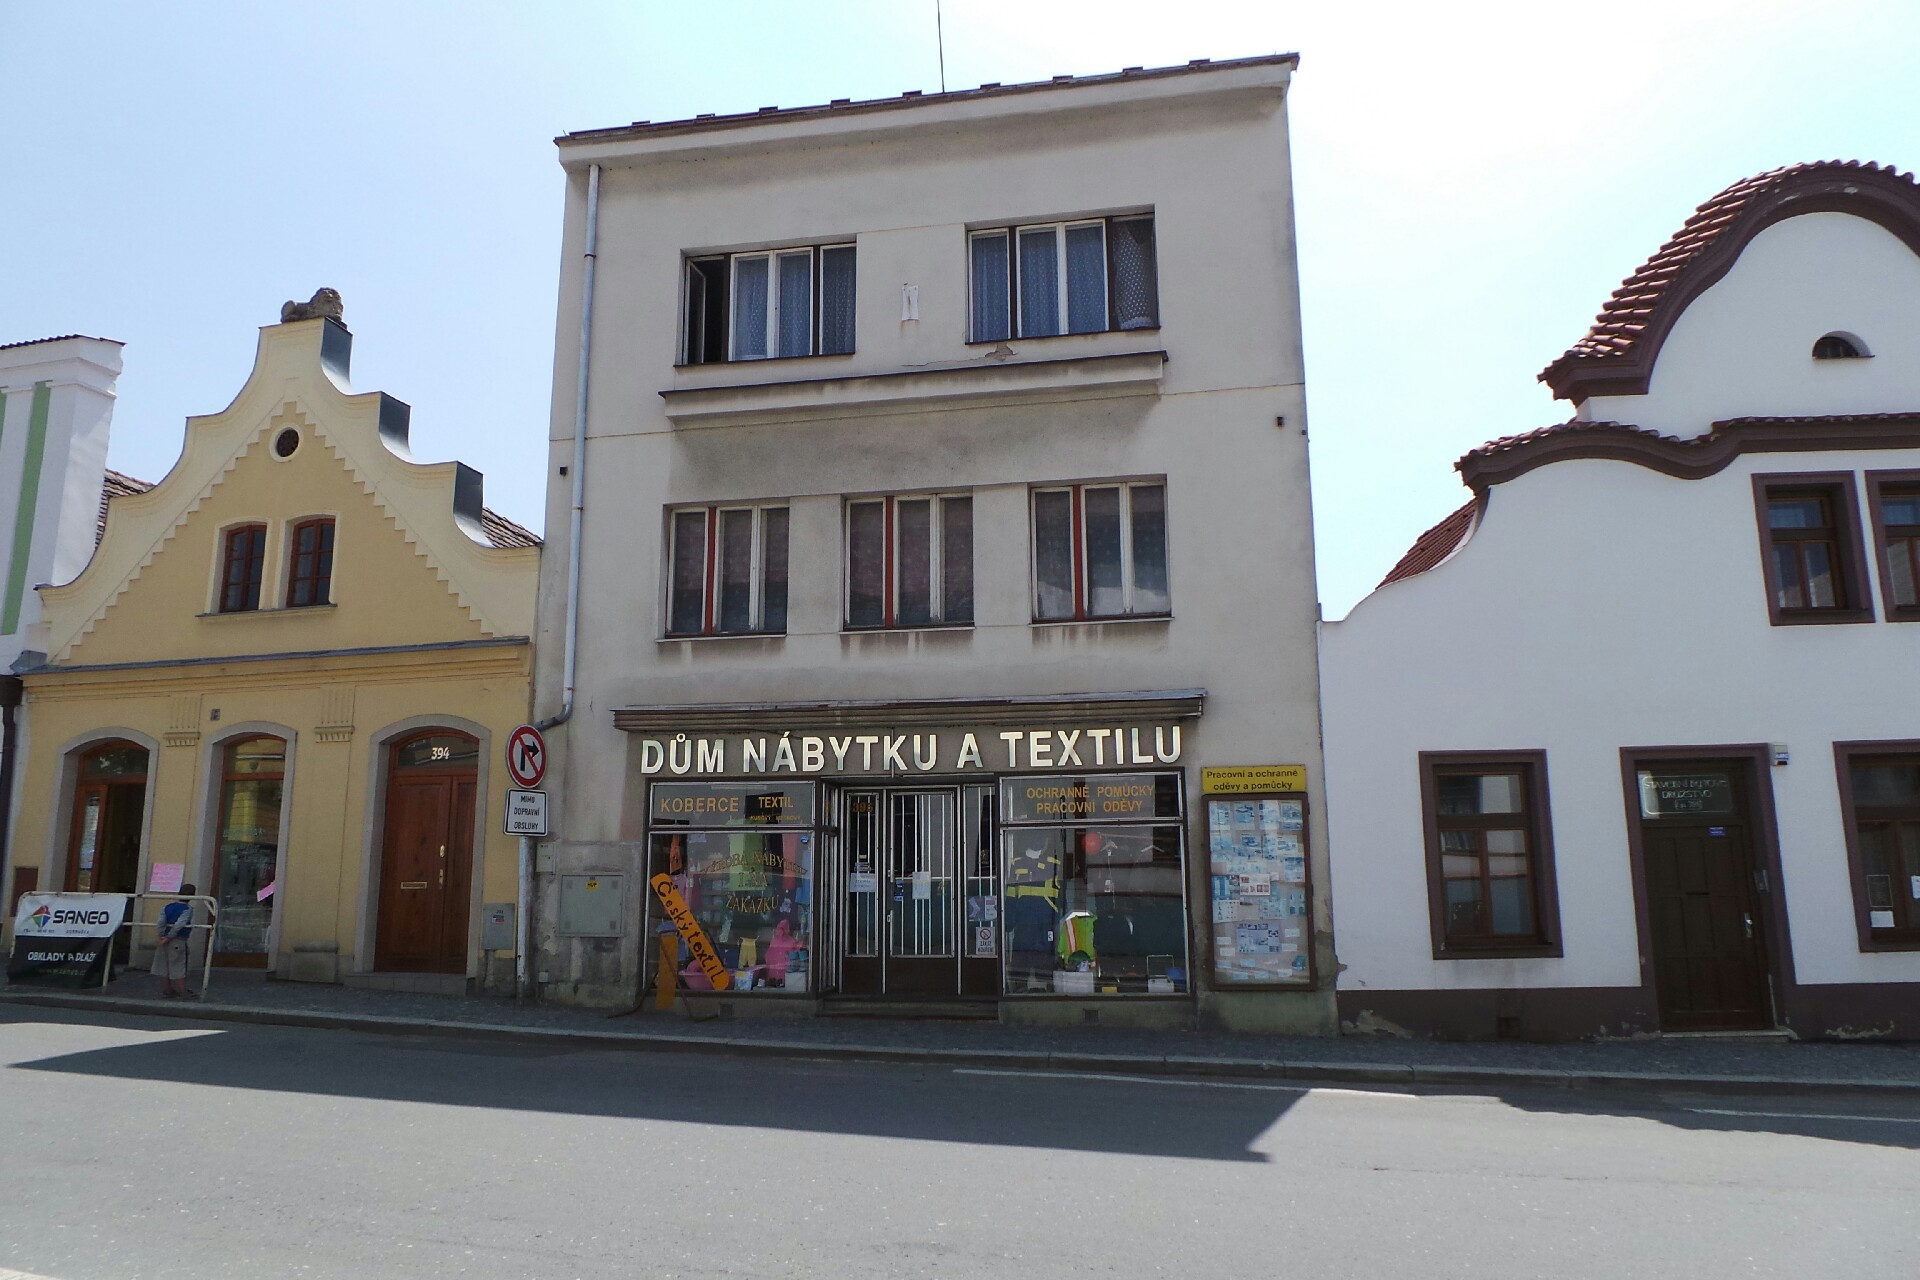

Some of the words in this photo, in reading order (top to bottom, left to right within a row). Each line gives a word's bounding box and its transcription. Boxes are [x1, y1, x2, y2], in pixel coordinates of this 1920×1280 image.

[431, 746, 450, 760] 394
[641, 733, 725, 774] DŮM
[743, 731, 938, 773] NÁBYTKU
[957, 733, 984, 769] A
[1000, 726, 1182, 767] TEXTILU
[1206, 769, 1245, 778] Pracovní
[1255, 769, 1298, 778] ochranné
[1026, 784, 1090, 799] OCHRANNÉ
[1213, 782, 1241, 791] oděvy
[1251, 780, 1293, 791] pomůcky
[520, 795, 535, 804] MIMO
[660, 796, 740, 813] KOBERCE
[758, 796, 794, 809] TEXTIL
[1036, 799, 1096, 814] PRACOVNÍ
[1103, 799, 1143, 812] ODĚVY
[513, 807, 541, 817] DOPRAVNÍ
[513, 821, 539, 831] OBSLUHY
[657, 880, 689, 932] Český
[726, 894, 780, 914] ZAKÁZKU
[53, 910, 110, 925] SANEO
[27, 951, 65, 962] OBKLADY
[67, 953, 74, 961] A
